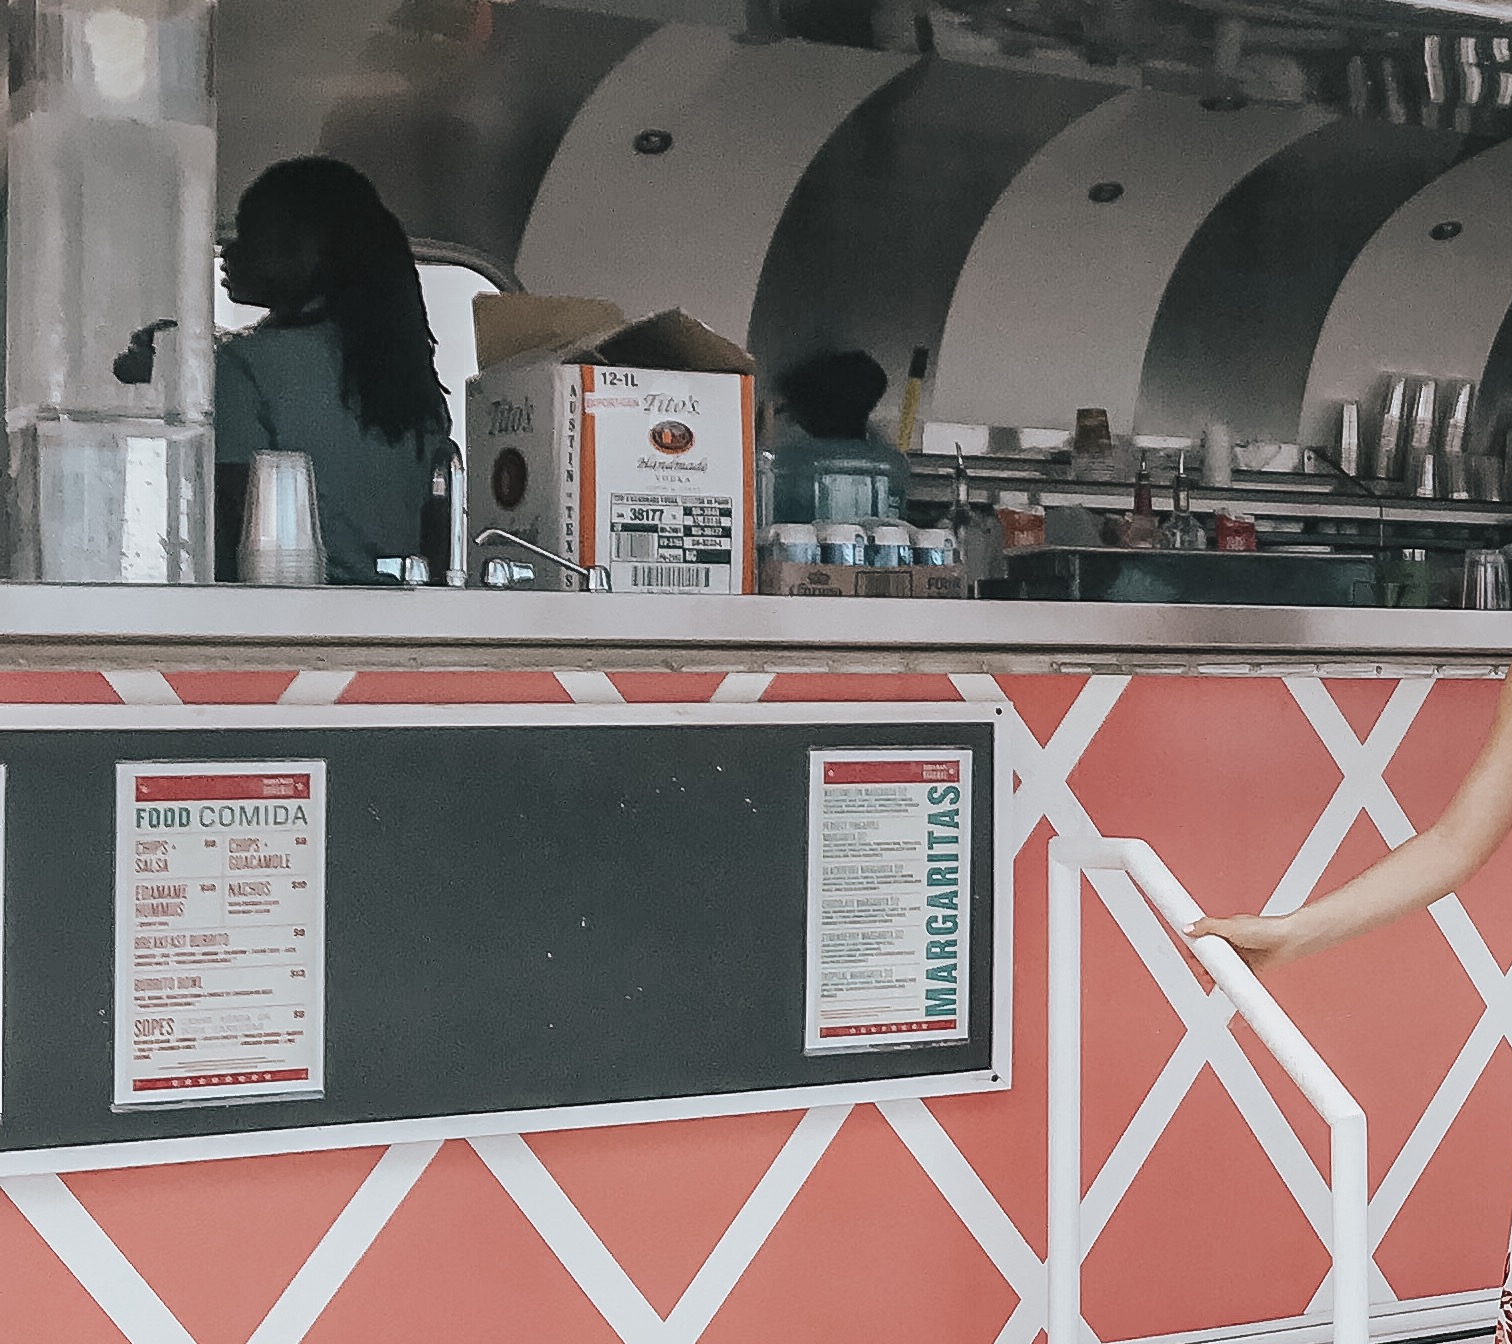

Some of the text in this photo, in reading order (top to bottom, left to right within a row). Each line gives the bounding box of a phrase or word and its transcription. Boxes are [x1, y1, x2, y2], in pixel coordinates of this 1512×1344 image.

[601, 371, 639, 387] 12-1L
[643, 393, 701, 415] Tito's
[564, 506, 575, 587] TEXS
[135, 805, 308, 829] FOOD COMIDA
[134, 858, 169, 873] SALSA
[925, 785, 961, 1017] MARGARITAS
[134, 1017, 175, 1037] SOPES
